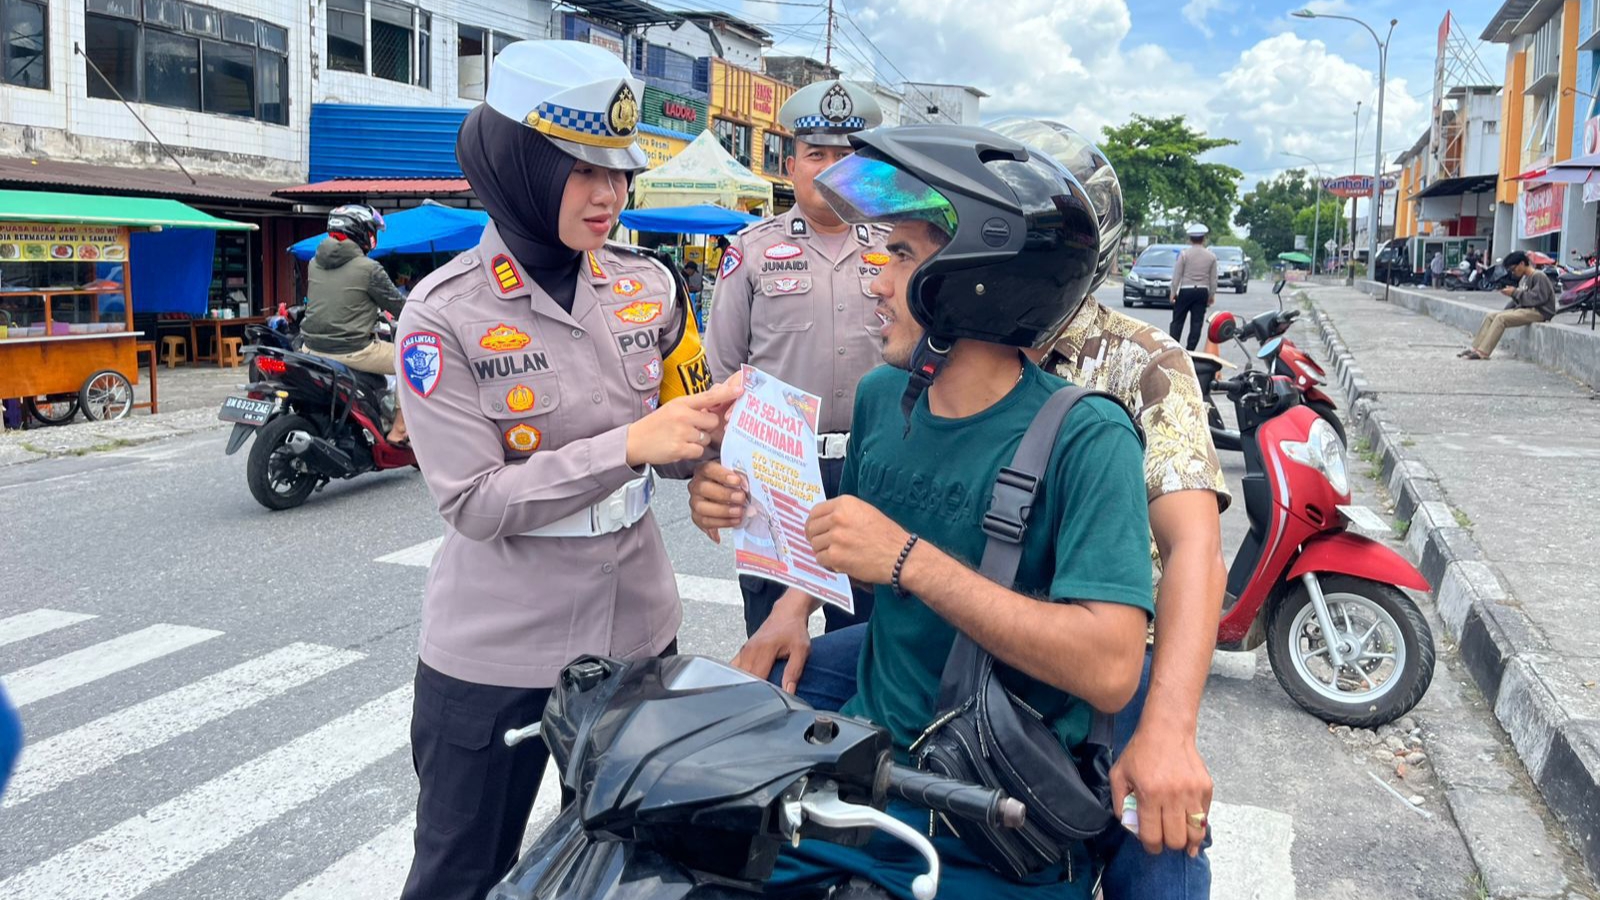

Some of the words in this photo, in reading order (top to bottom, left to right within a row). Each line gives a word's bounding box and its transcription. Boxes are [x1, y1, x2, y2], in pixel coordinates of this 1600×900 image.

[665, 102, 697, 122] LADORA
[651, 138, 669, 150] Resmi
[32, 225, 56, 233] BUKA
[59, 226, 76, 234] JAM
[762, 260, 809, 273] JUNAIDI
[415, 335, 437, 344] LINTAS
[474, 351, 550, 380] WULAN
[760, 403, 804, 438] SELAMAT
[737, 411, 804, 460] BERKENDARA
